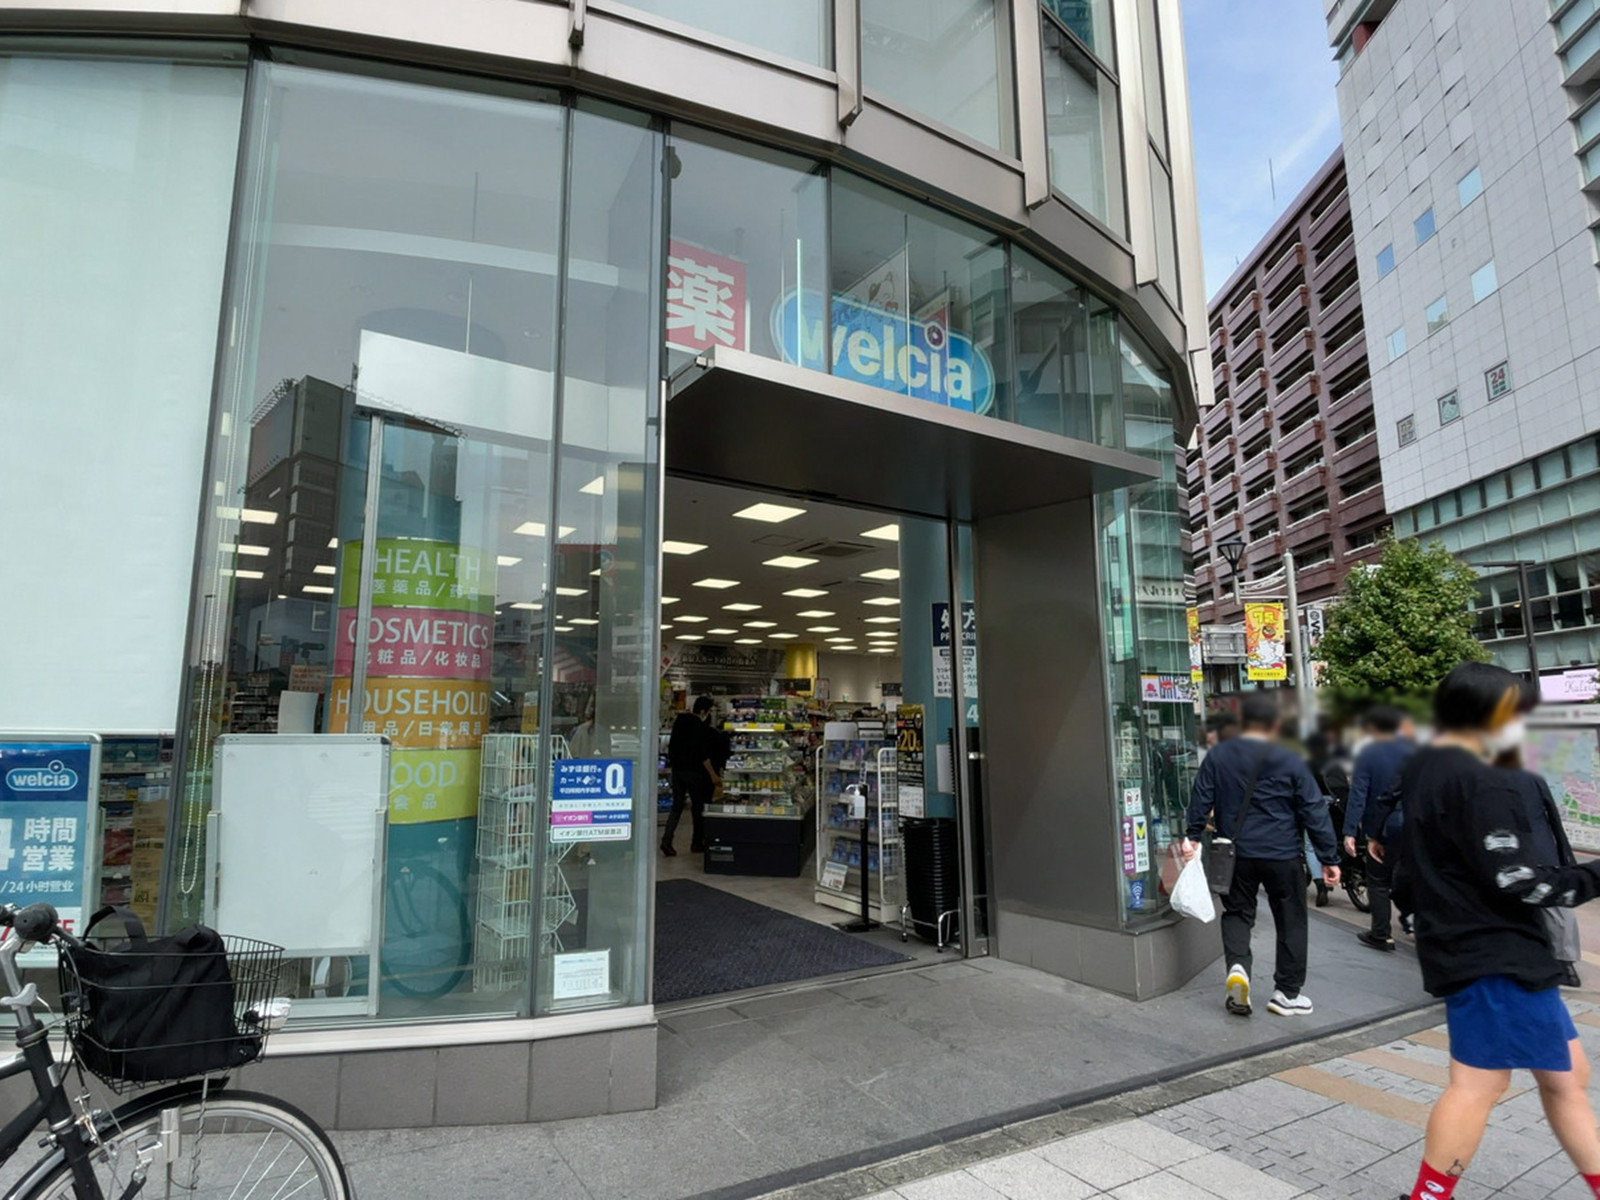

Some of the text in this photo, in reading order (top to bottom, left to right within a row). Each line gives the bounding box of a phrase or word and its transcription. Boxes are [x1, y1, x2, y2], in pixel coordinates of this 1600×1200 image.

[667, 256, 736, 346] 薬
[798, 313, 973, 401] welcia
[1490, 368, 1506, 385] 24
[374, 548, 480, 582] HEALTH
[347, 617, 489, 650] COSMETICS
[366, 649, 481, 668] 粧品/化妆品
[336, 689, 488, 716] HOUSEHOLD
[345, 720, 482, 737] 用品/日常用品
[12, 771, 71, 787] welcia
[391, 760, 457, 788] OOD
[24, 817, 78, 843] 時間
[22, 845, 76, 872] 営業
